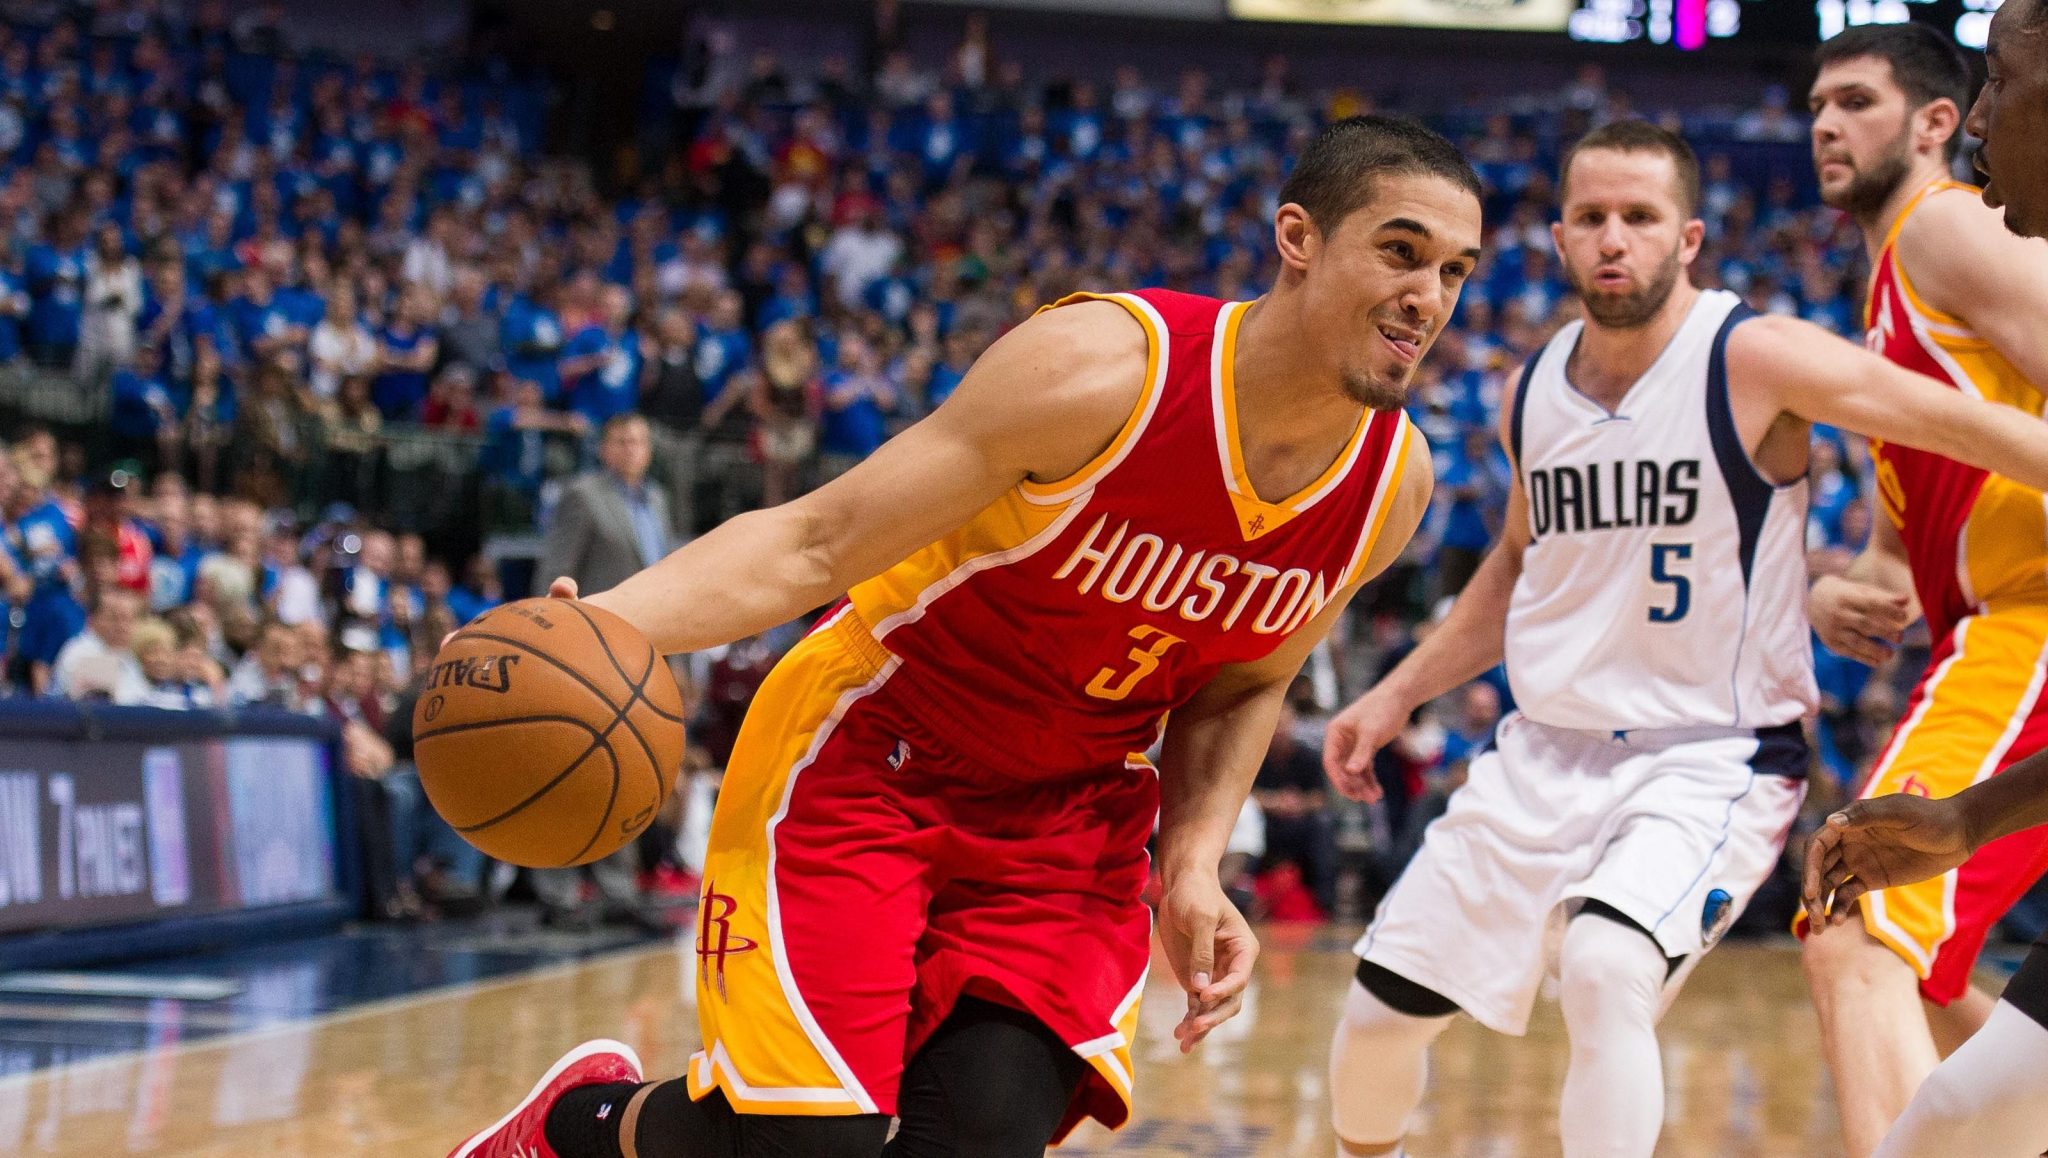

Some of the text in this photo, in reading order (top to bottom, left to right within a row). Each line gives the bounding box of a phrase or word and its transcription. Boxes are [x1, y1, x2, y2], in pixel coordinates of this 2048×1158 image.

[1531, 459, 1700, 536] DALLAS
[1052, 512, 1347, 636] HOUSTON
[1648, 543, 1693, 623] 5
[1085, 624, 1188, 701] 3
